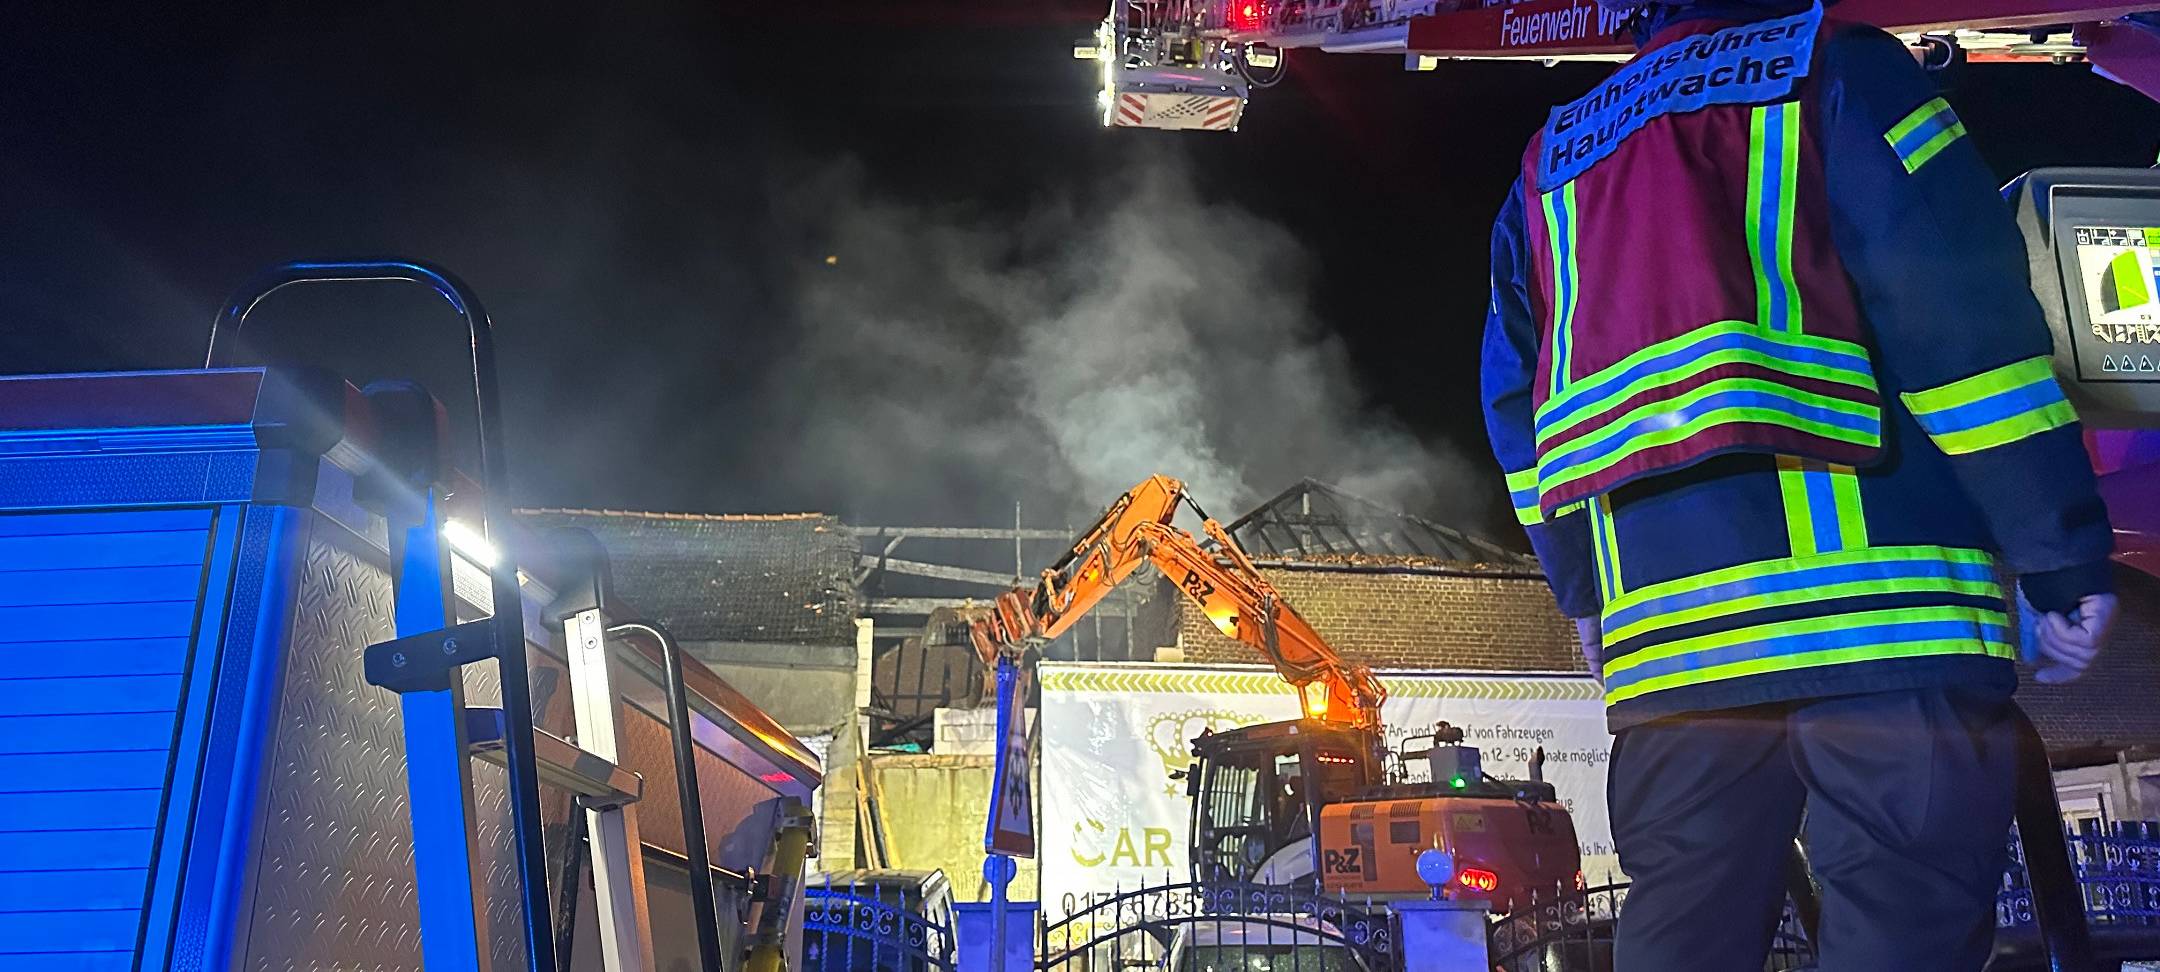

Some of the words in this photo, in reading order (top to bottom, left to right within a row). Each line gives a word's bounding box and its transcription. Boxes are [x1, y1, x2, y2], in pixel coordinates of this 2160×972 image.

[1501, 1, 1592, 46] Feuerwehr
[1554, 21, 1806, 134] Einheitsführer
[1550, 54, 1794, 173] Hauptwache
[1182, 569, 1215, 607] P&Z
[1474, 728, 1494, 739] von
[1495, 724, 1554, 744] Fahrzeugen
[1491, 747, 1503, 762] 12
[1513, 747, 1529, 762] 96
[1324, 848, 1361, 874] P&Z
